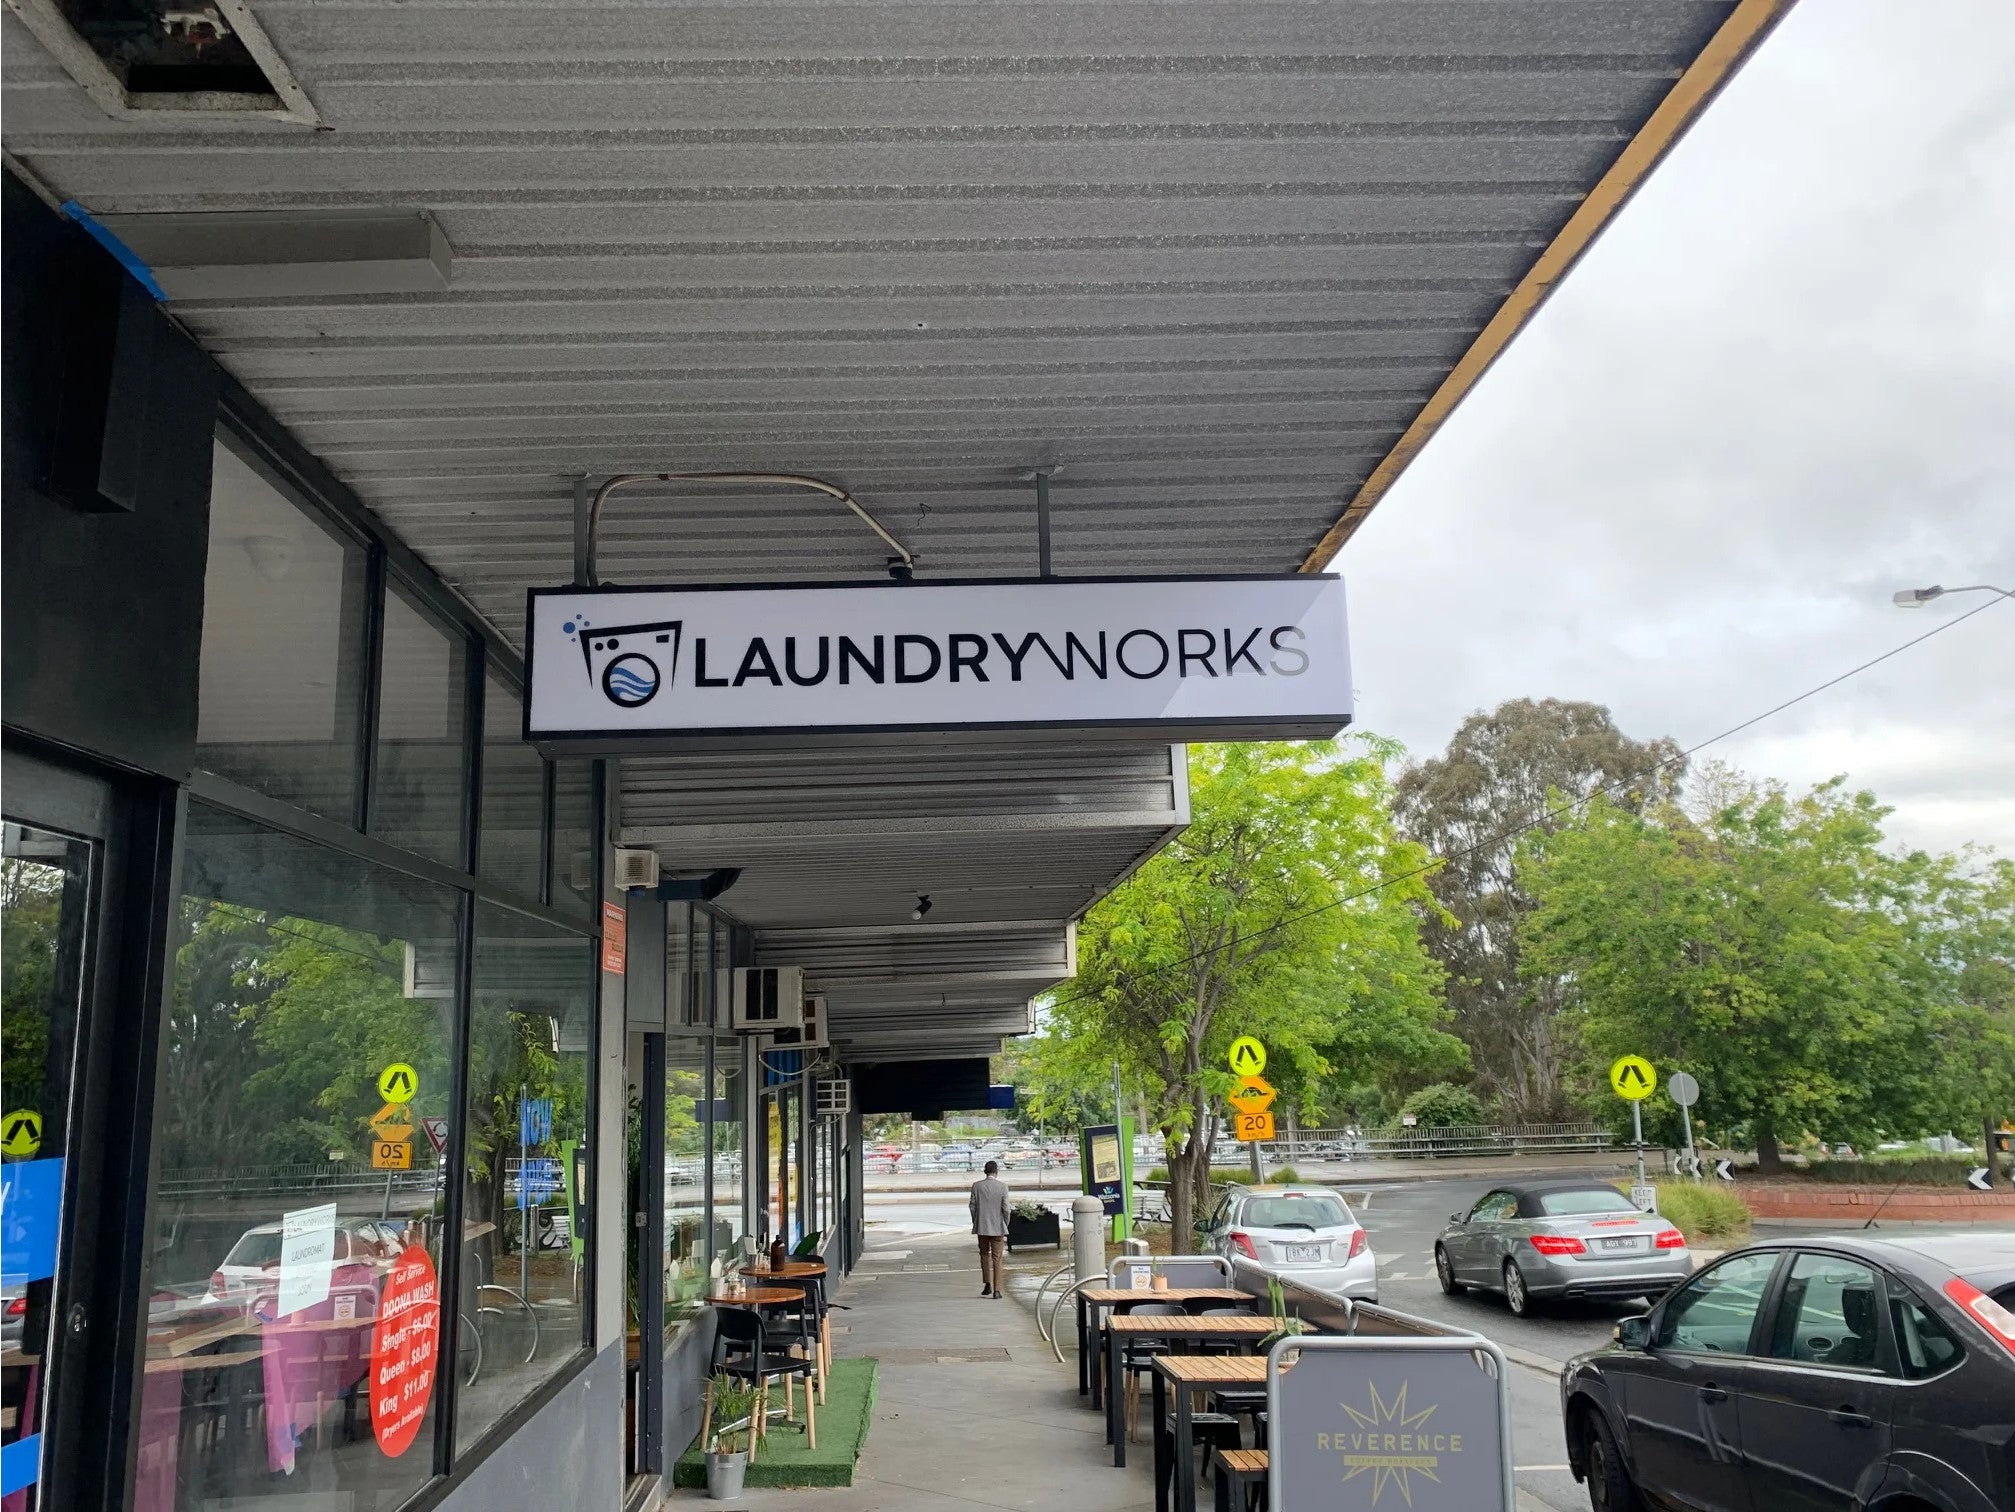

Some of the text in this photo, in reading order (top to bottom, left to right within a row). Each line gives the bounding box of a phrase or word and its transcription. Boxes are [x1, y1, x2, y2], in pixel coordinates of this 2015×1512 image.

[694, 624, 1311, 689] LAUNDRYWORKS
[1244, 1115, 1266, 1131] 20
[1634, 1189, 1652, 1197] KEEP
[1635, 1198, 1652, 1206] LEFT
[291, 1242, 326, 1262] LAUNDROMAT
[395, 1264, 426, 1285] Self Service
[382, 1280, 435, 1319] DOONA WASH
[382, 1327, 406, 1352] Single
[412, 1311, 432, 1336] $6.00
[380, 1359, 405, 1385] Queen
[411, 1340, 431, 1367] $8.00
[379, 1371, 429, 1419] King $11.00
[1317, 1432, 1464, 1452] REVERENCE
